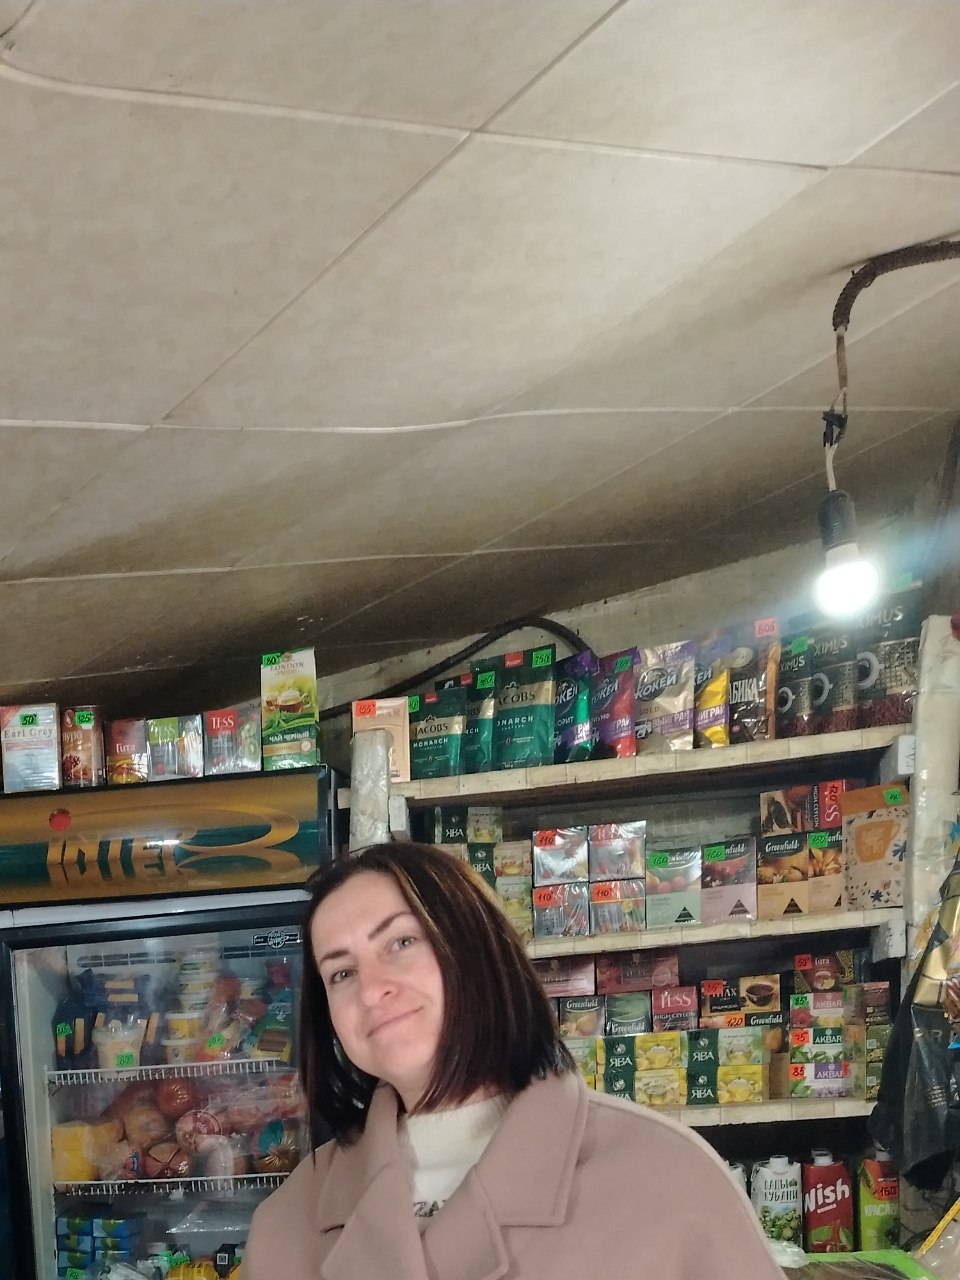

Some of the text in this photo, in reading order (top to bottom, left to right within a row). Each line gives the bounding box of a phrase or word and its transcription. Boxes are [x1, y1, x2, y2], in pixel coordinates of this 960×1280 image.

[634, 672, 678, 700] ЖОКЕЙ
[496, 690, 537, 706] ACOBS
[211, 715, 235, 730] TESS
[4, 727, 54, 740] Earl Grey
[415, 722, 449, 736] JACOBS
[269, 733, 283, 742] ЧАЙ
[413, 736, 449, 748] MONARCH
[765, 839, 800, 854] Greenfield
[566, 998, 599, 1010] Greenfield
[660, 991, 692, 1009] TESS
[726, 1016, 743, 1027] 120
[750, 1014, 783, 1026] Greenfield
[612, 1021, 646, 1033] Greenfield
[792, 1067, 805, 1077] 85
